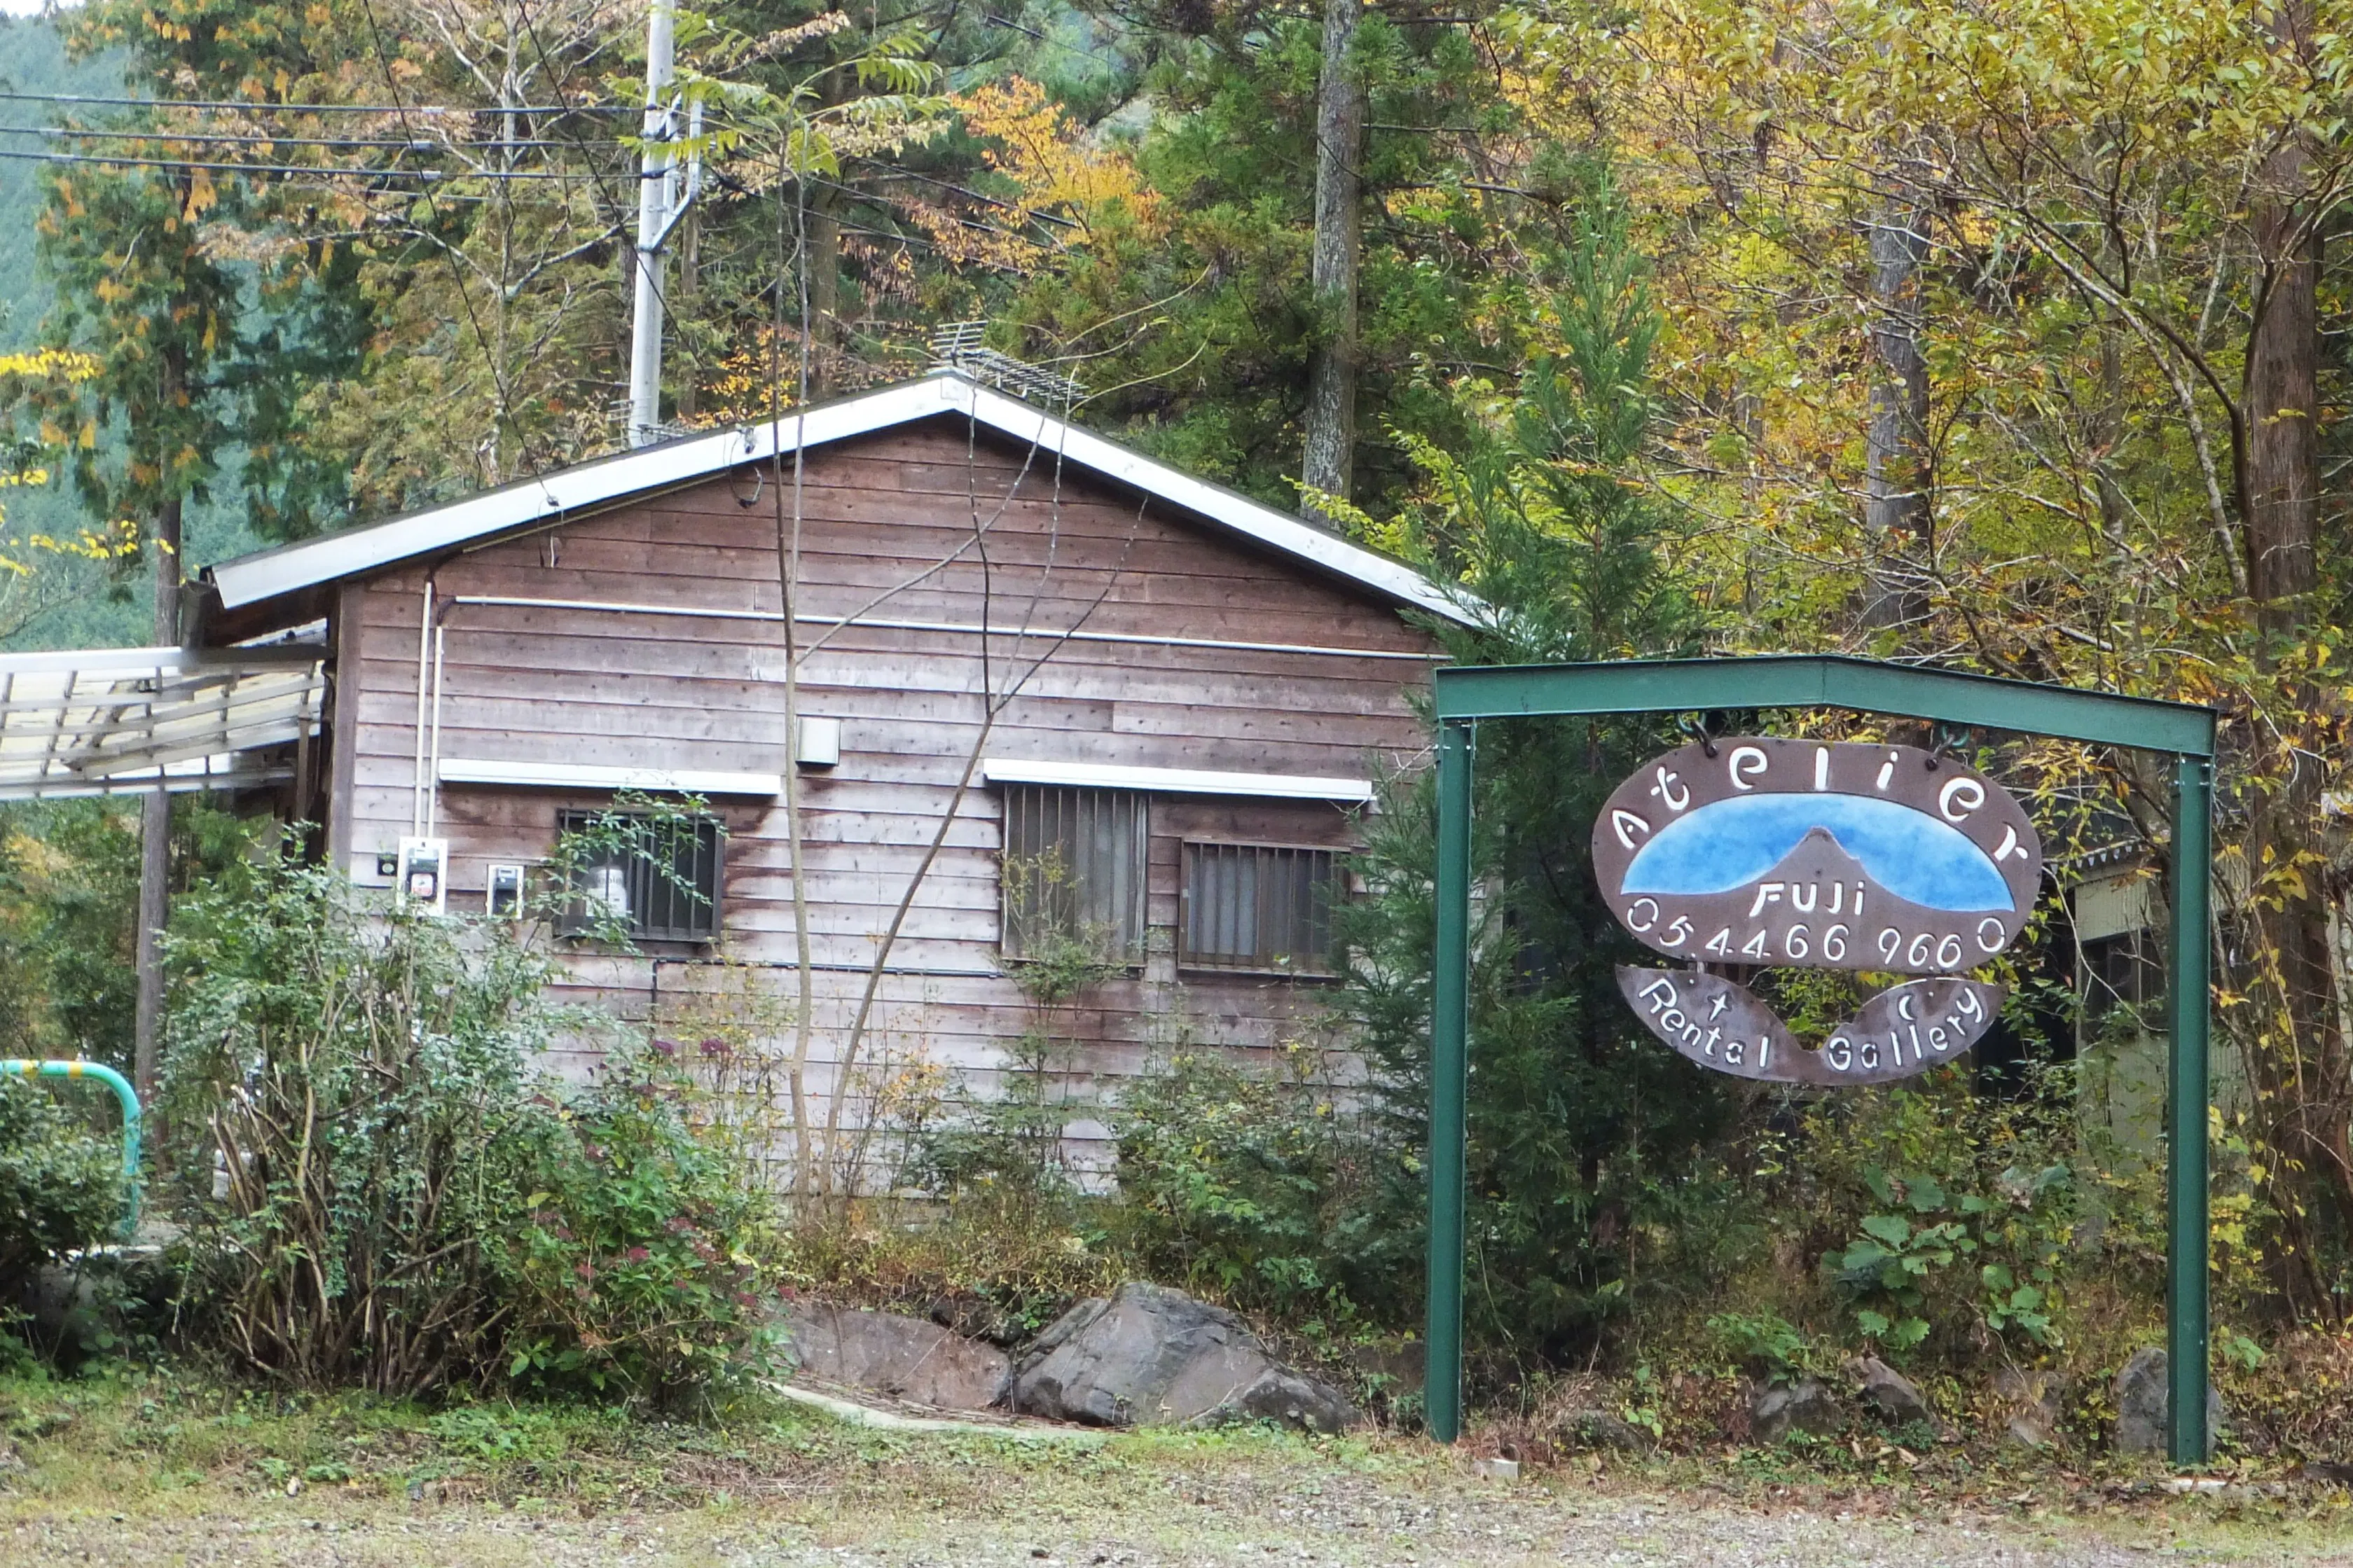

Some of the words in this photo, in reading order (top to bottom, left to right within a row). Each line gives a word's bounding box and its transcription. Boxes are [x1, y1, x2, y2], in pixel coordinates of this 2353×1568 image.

[1611, 746, 2029, 861] Atelier
[1638, 976, 1769, 1068] Rental
[1827, 986, 1983, 1071] Gallery
